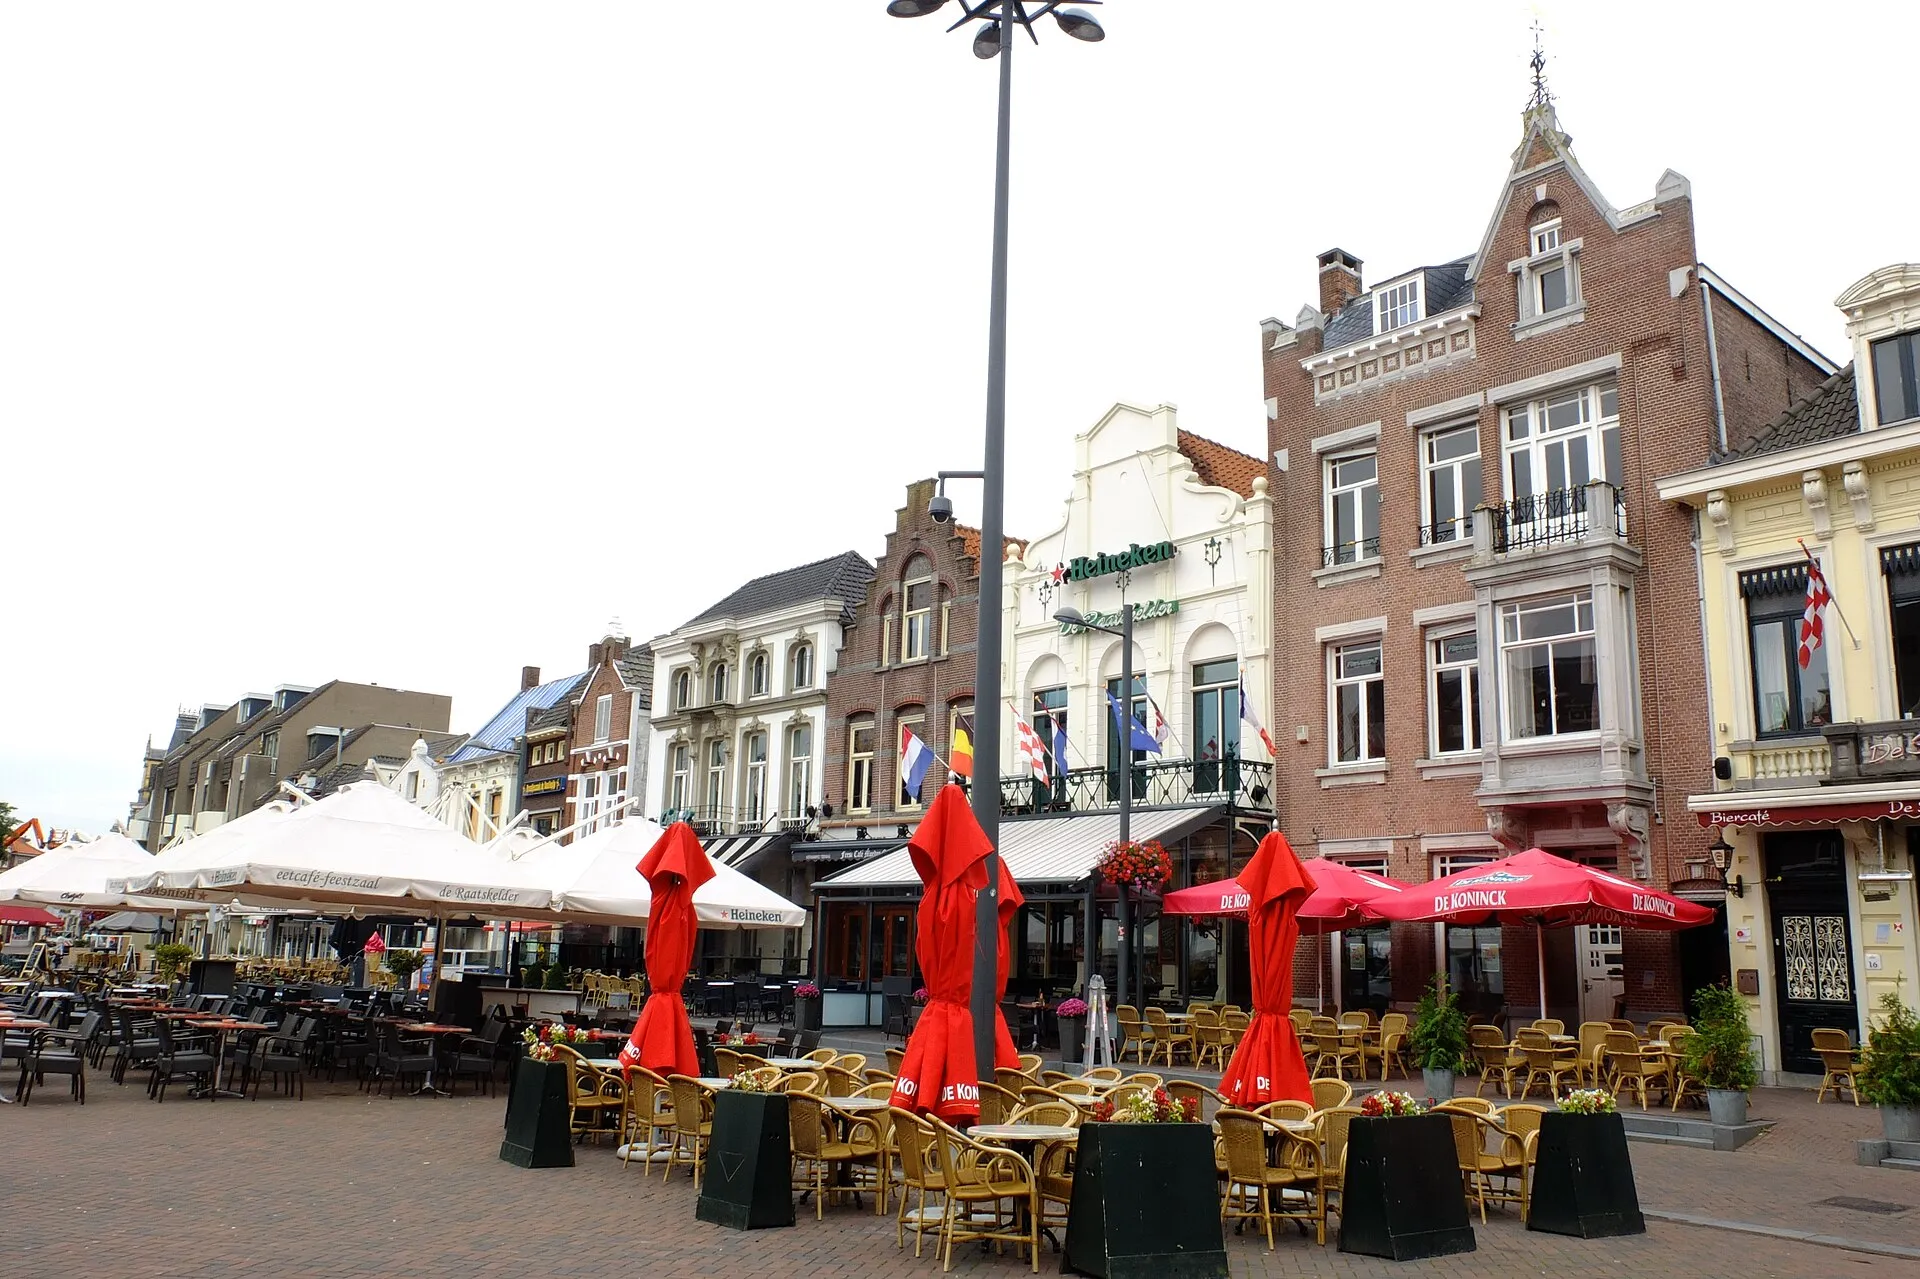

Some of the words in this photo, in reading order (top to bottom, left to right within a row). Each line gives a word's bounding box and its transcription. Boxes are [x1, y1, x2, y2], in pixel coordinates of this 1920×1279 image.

[1070, 541, 1175, 581] Heineken
[1868, 743, 1904, 763] De
[1889, 801, 1914, 814] De
[1710, 810, 1771, 824] Biercafé
[276, 869, 382, 890] eetcafé-feestzaal
[439, 885, 452, 898] de
[454, 887, 520, 903] Raatskelder
[1220, 895, 1233, 909] DE
[1435, 896, 1450, 912] DE
[1450, 889, 1507, 910] KONINCK
[1632, 893, 1643, 911] DE
[1643, 894, 1676, 917] KONINCK
[731, 908, 782, 922] Heineken
[1868, 960, 1878, 968] 16
[1256, 1076, 1270, 1090] DE
